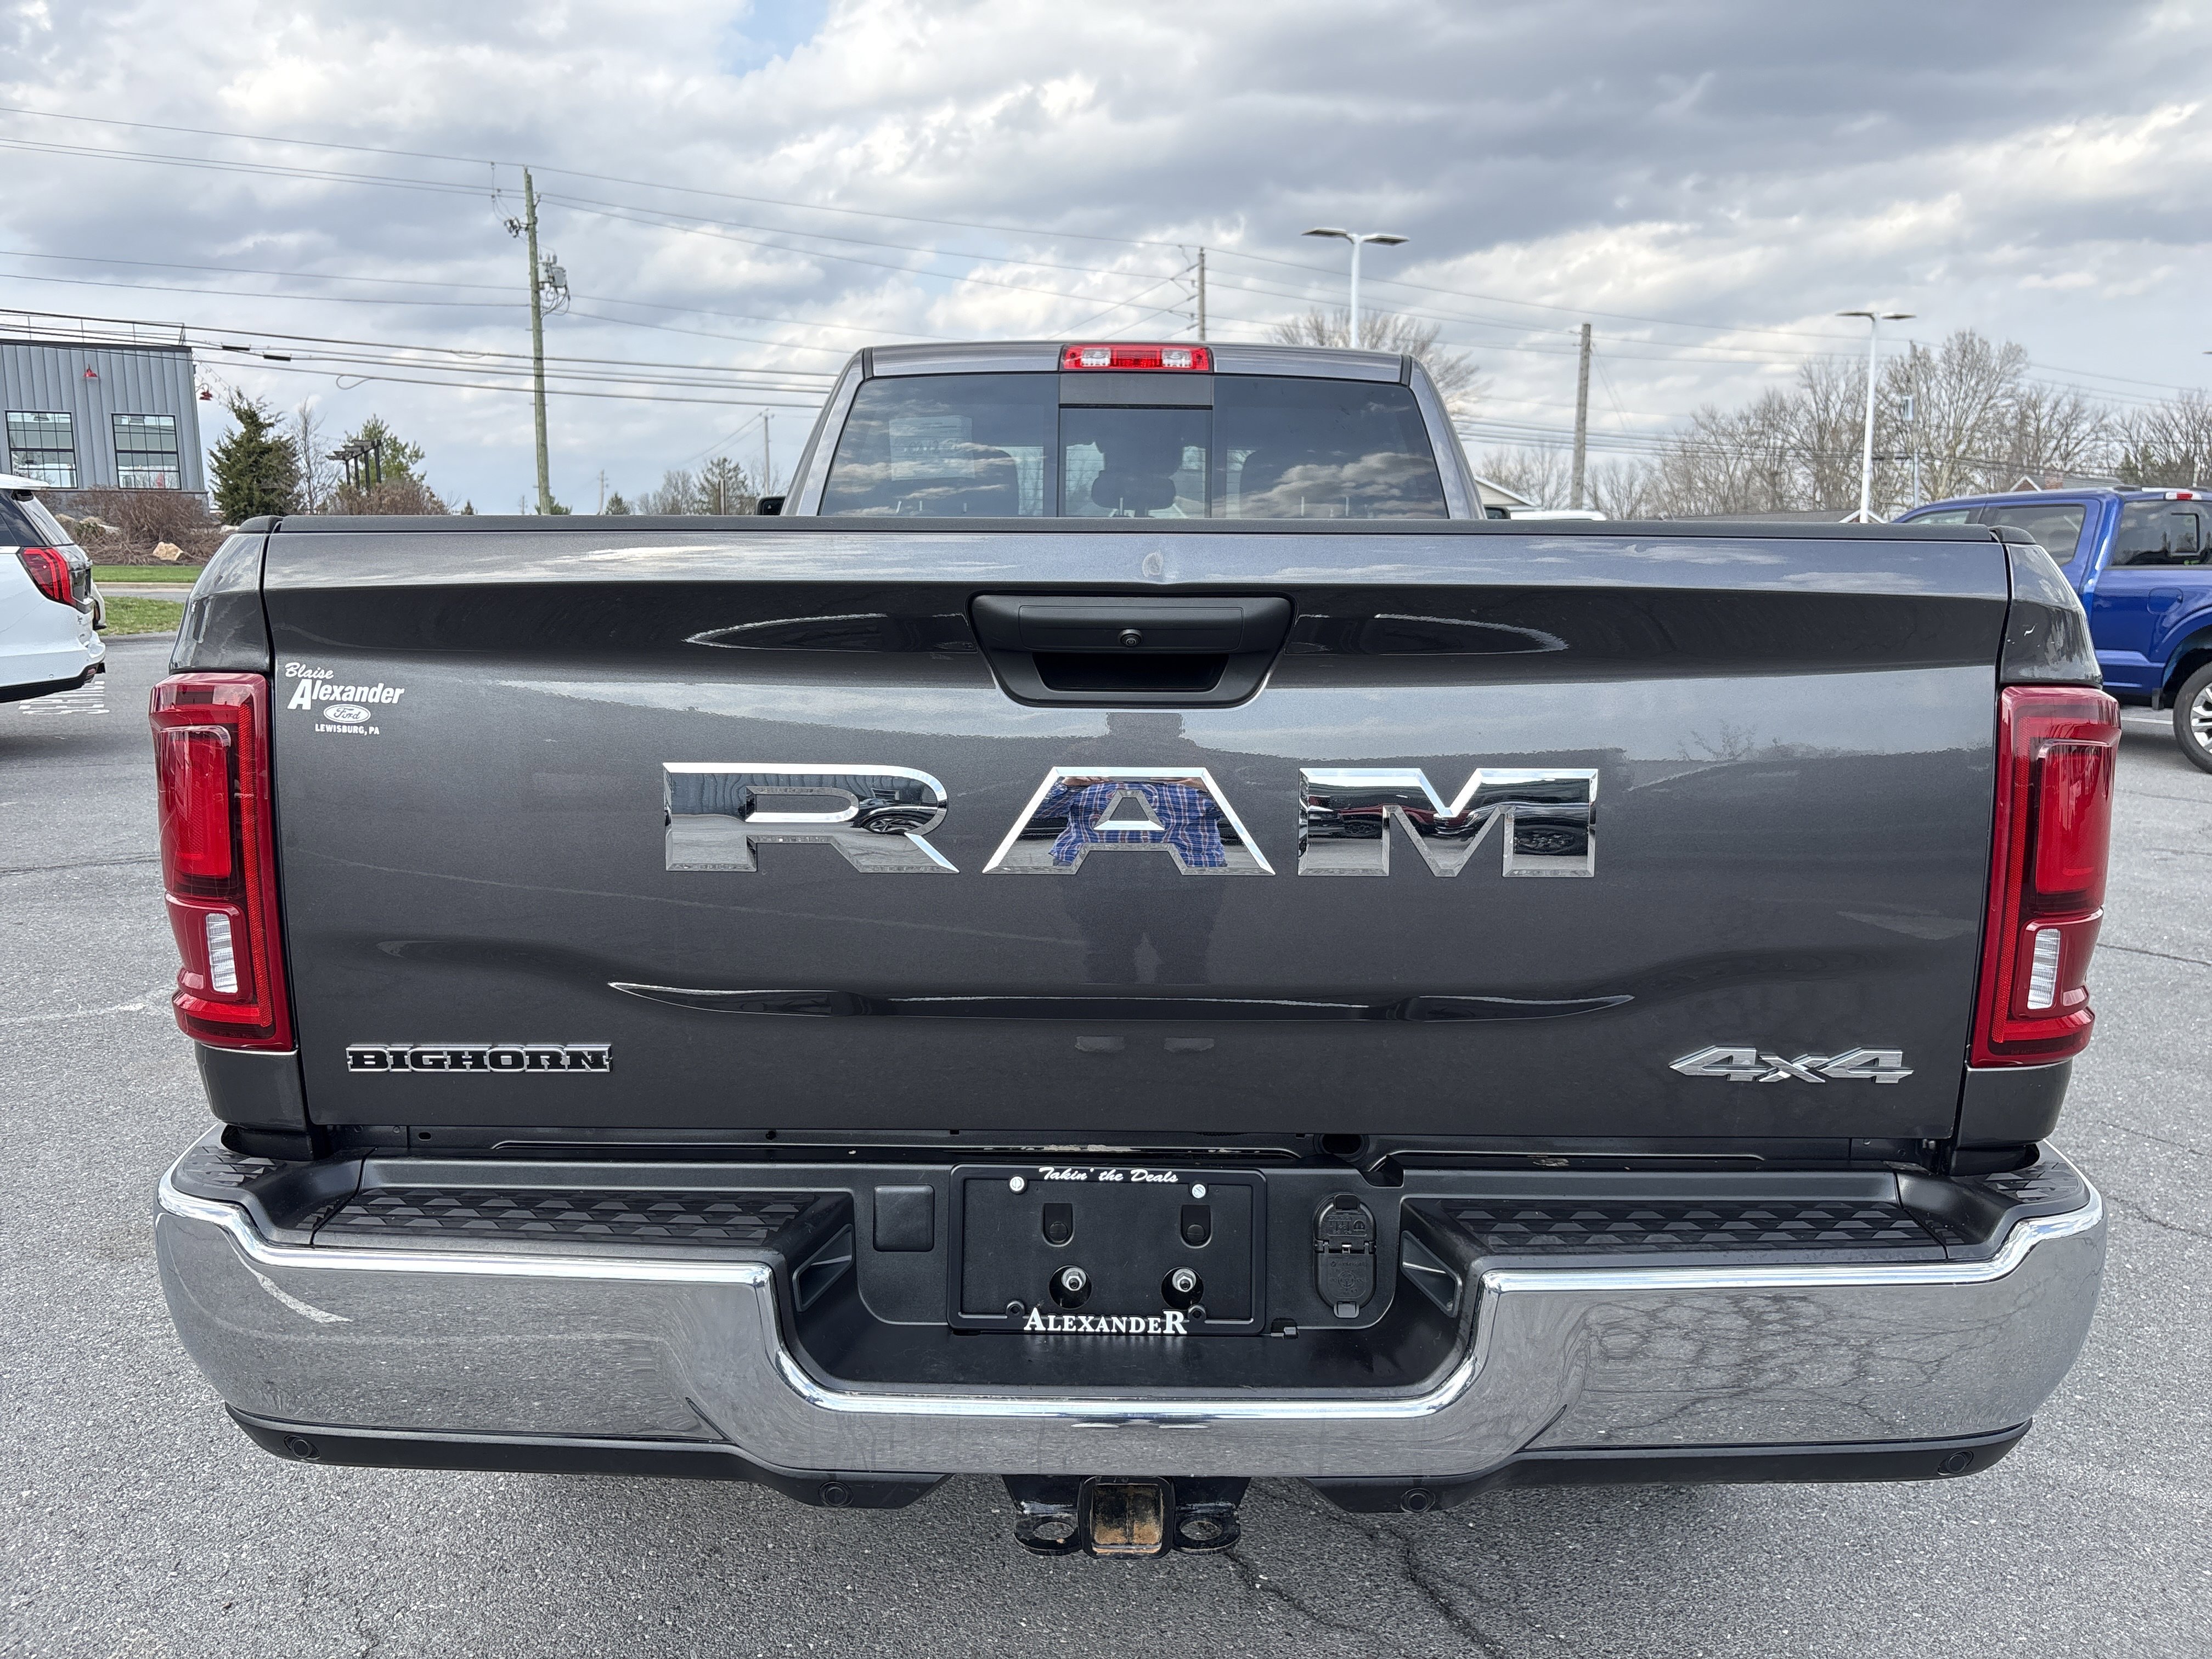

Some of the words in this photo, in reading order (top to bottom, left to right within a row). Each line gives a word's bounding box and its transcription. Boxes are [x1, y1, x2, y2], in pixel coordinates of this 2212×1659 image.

[285, 662, 334, 679] Blaise
[287, 679, 405, 710] Alexander
[315, 723, 367, 736] LEWISBURG,
[369, 726, 380, 735] PA
[662, 761, 1599, 878] RAM
[346, 1043, 614, 1073] BIGHORN
[1039, 1166, 1094, 1181] Takin'
[1098, 1169, 1124, 1181] the
[1130, 1168, 1179, 1182] Deals
[1023, 1307, 1187, 1334] ALEXANDER
